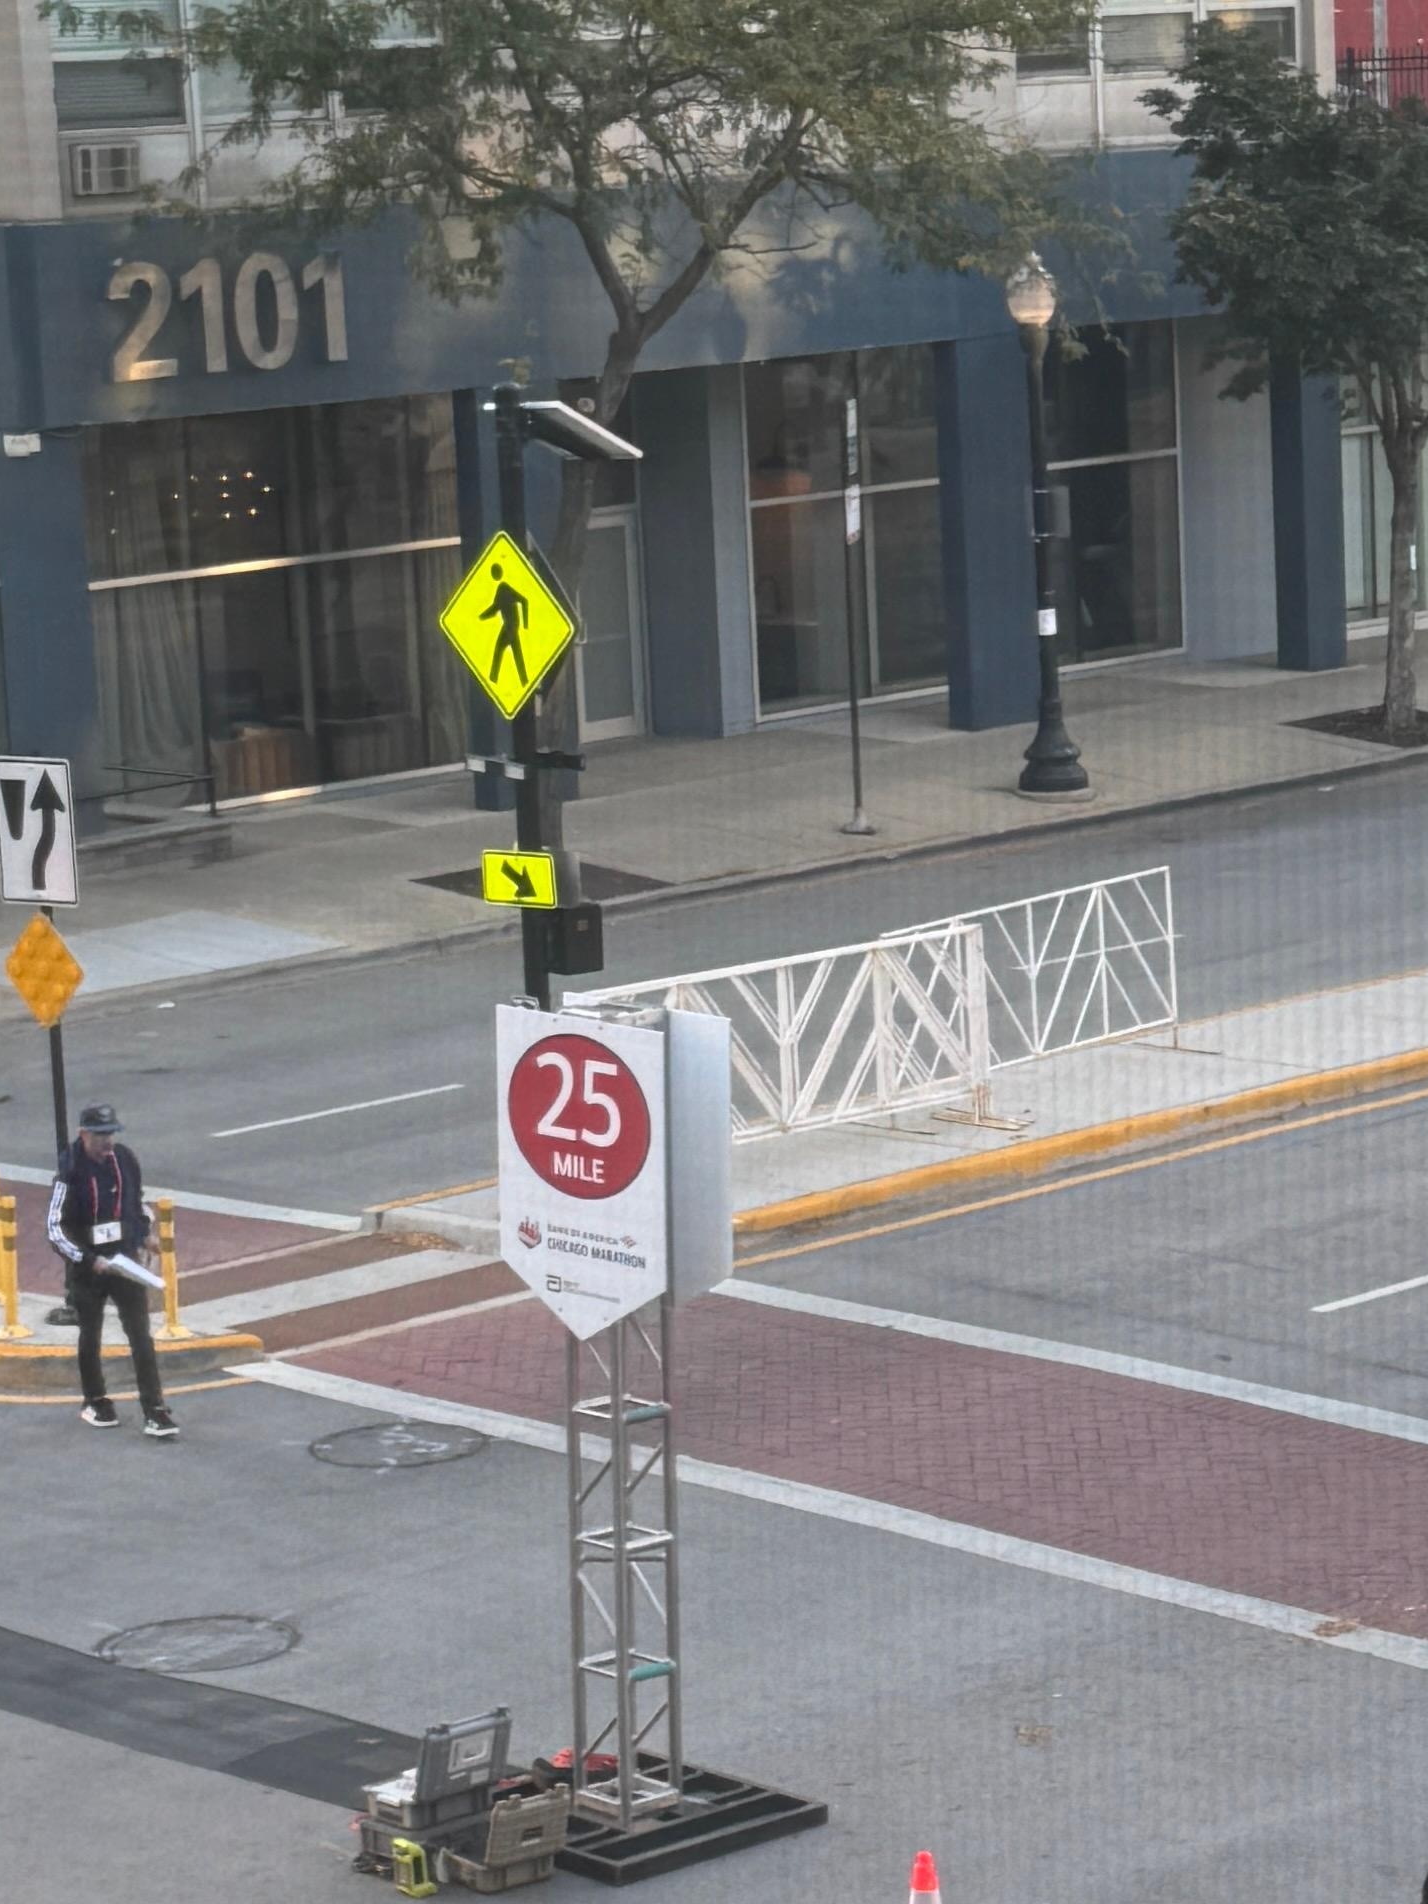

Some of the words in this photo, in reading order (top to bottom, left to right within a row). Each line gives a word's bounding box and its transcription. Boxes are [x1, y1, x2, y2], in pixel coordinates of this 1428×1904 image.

[107, 251, 348, 384] 2101
[536, 1051, 622, 1148] 25
[553, 1151, 606, 1184] MILE
[547, 1237, 589, 1257] CHICAGO
[591, 1247, 646, 1270] MARATHON
